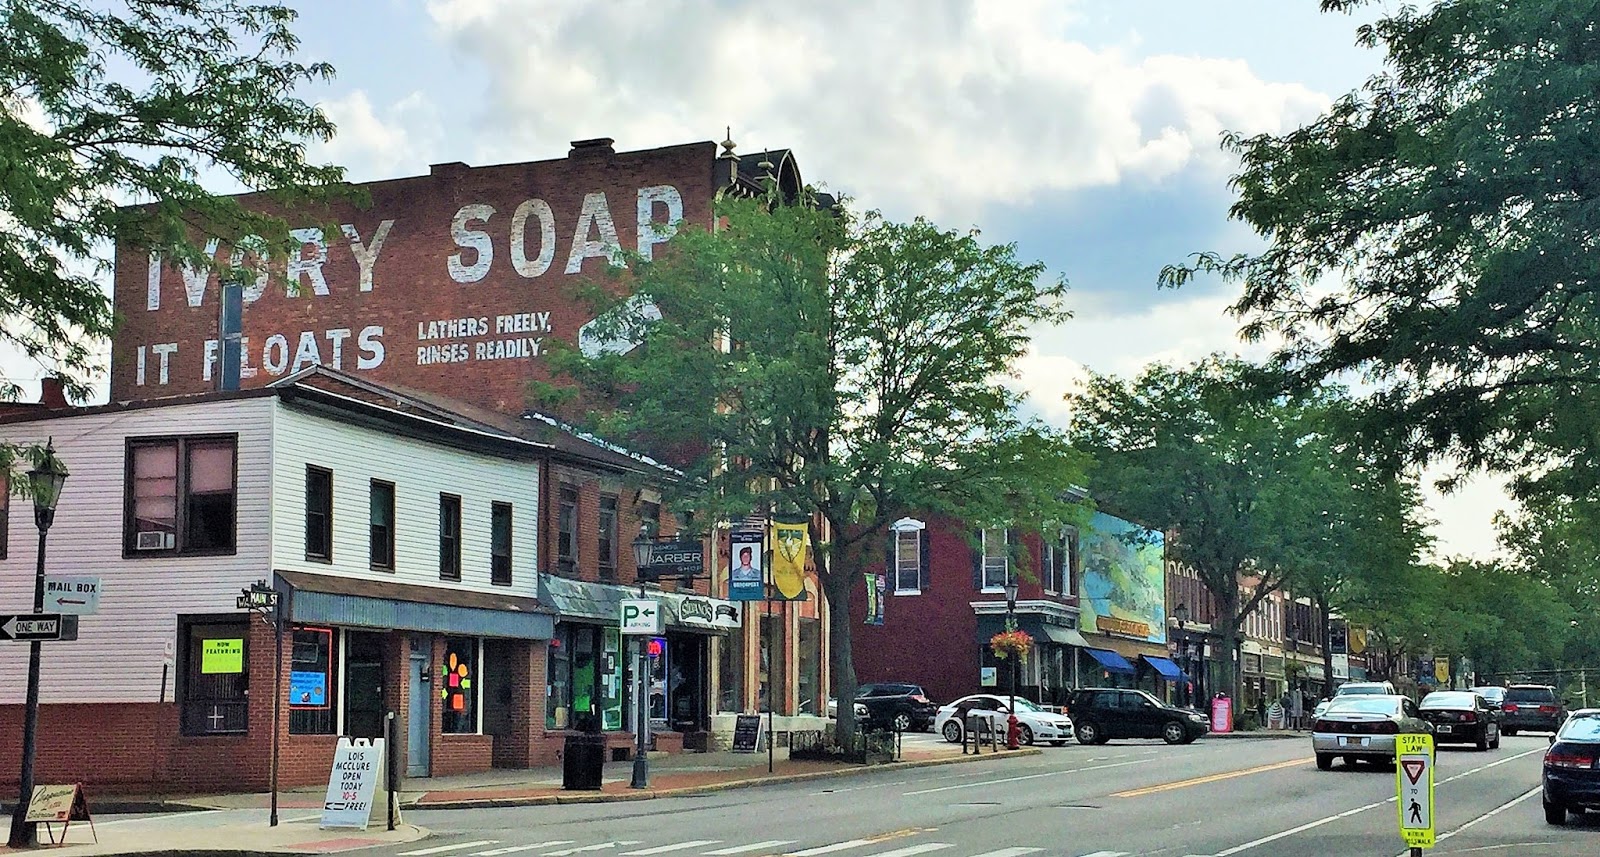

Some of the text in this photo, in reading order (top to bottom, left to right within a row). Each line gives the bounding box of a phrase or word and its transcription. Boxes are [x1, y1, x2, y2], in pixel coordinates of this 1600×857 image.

[147, 184, 684, 311] IVORY SOAP
[418, 312, 552, 340] LATHERS FREELY,
[417, 343, 470, 365] RINSES
[136, 343, 178, 386] IT
[48, 582, 97, 593] MAIL BOX
[250, 592, 267, 604] MAIN
[269, 594, 279, 605] ST
[624, 605, 640, 628] P
[16, 621, 56, 632] ONE WAY
[1402, 736, 1427, 744] STATE
[348, 752, 365, 760] LOIS
[336, 762, 371, 771] MCCLURE
[342, 772, 362, 780] OPEN
[340, 782, 363, 791] TODAY
[342, 791, 357, 801] 10-5
[344, 802, 367, 811] FREE!
